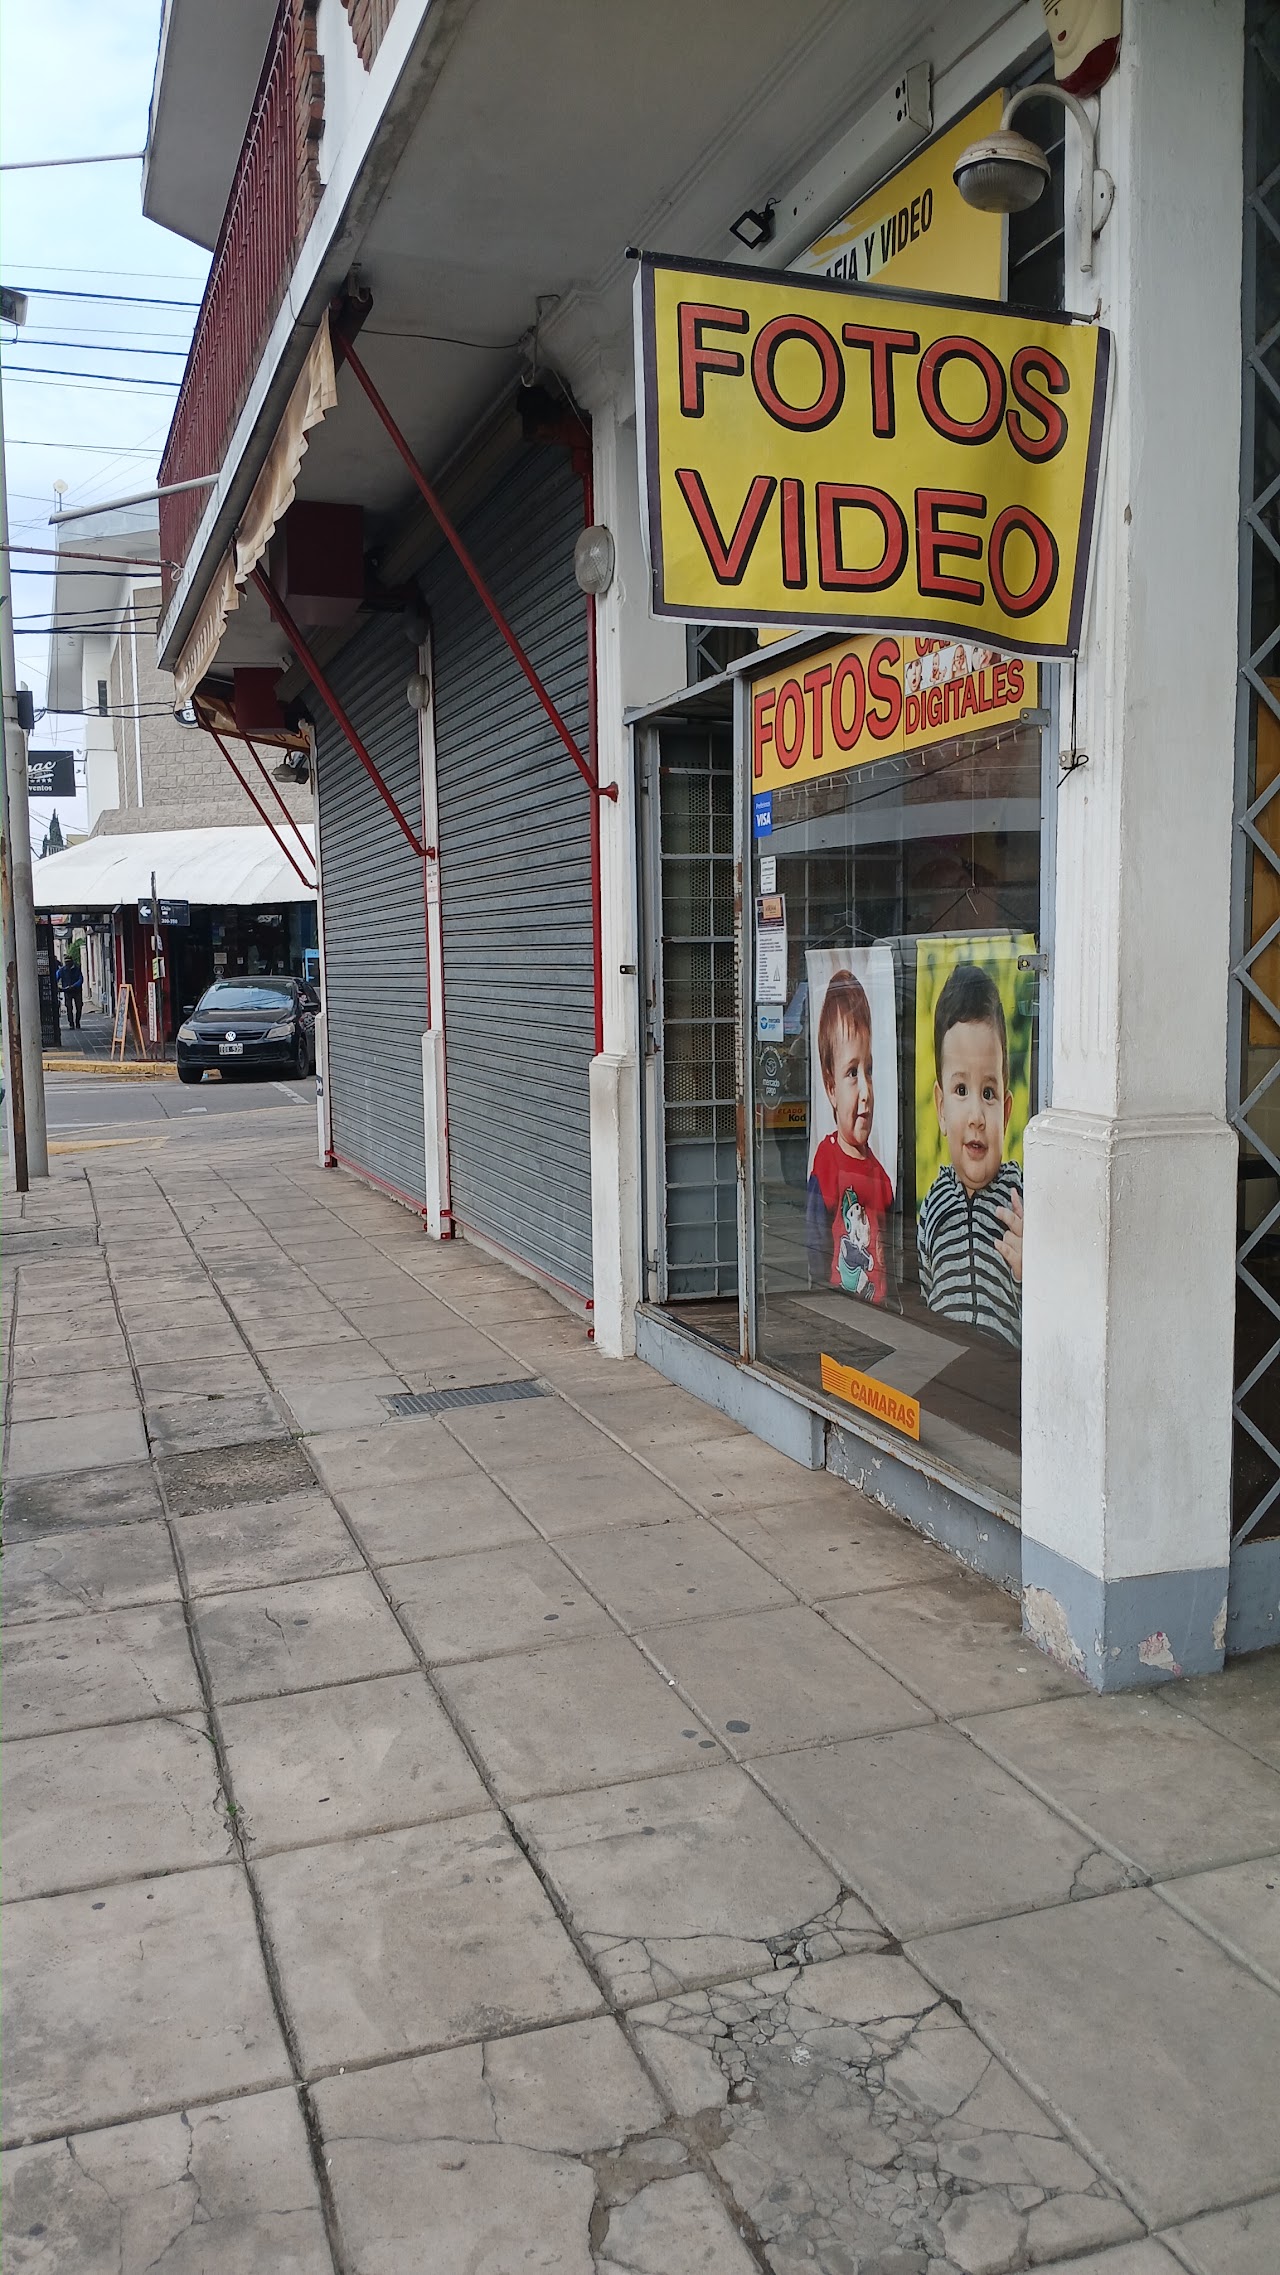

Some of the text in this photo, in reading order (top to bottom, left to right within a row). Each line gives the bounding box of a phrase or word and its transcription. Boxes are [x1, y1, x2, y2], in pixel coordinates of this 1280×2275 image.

[864, 231, 875, 276] Y
[880, 187, 933, 264] VIDEO
[677, 302, 1070, 464] FOTOS
[674, 469, 1060, 619] VIDEO
[754, 637, 903, 778] FOTOS
[905, 658, 1025, 735] DIGITALES
[756, 812, 771, 828] VISA
[762, 1078, 780, 1088] mercado
[765, 1087, 777, 1097] pago
[788, 1113, 806, 1122] Kod
[850, 1380, 915, 1429] CAMARAS
